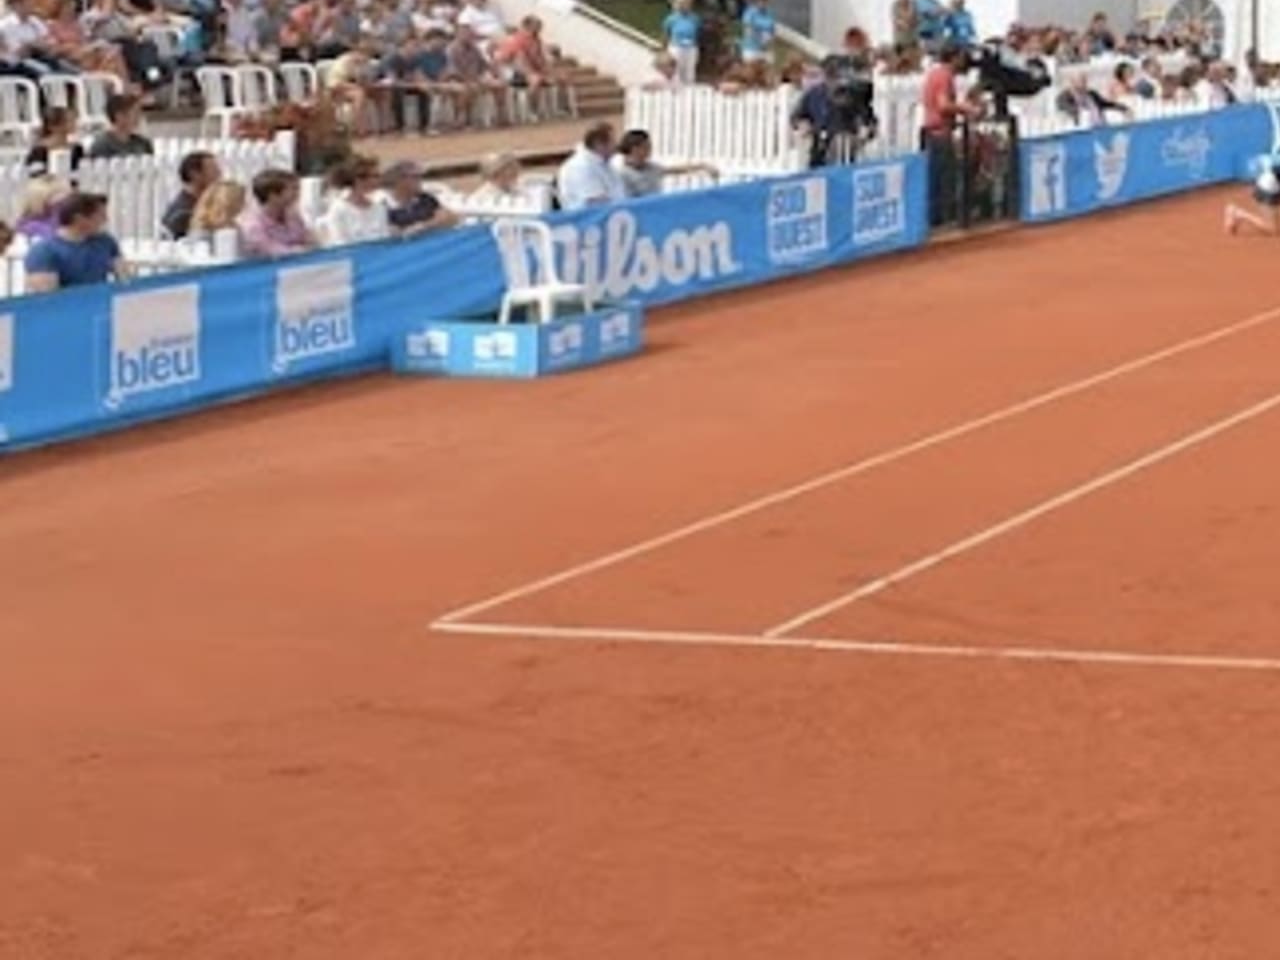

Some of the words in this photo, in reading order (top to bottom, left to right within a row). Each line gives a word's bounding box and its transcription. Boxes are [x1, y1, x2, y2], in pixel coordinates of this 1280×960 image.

[496, 209, 743, 303] Wilson
[280, 315, 349, 354] bleu
[116, 343, 195, 389] bleu
